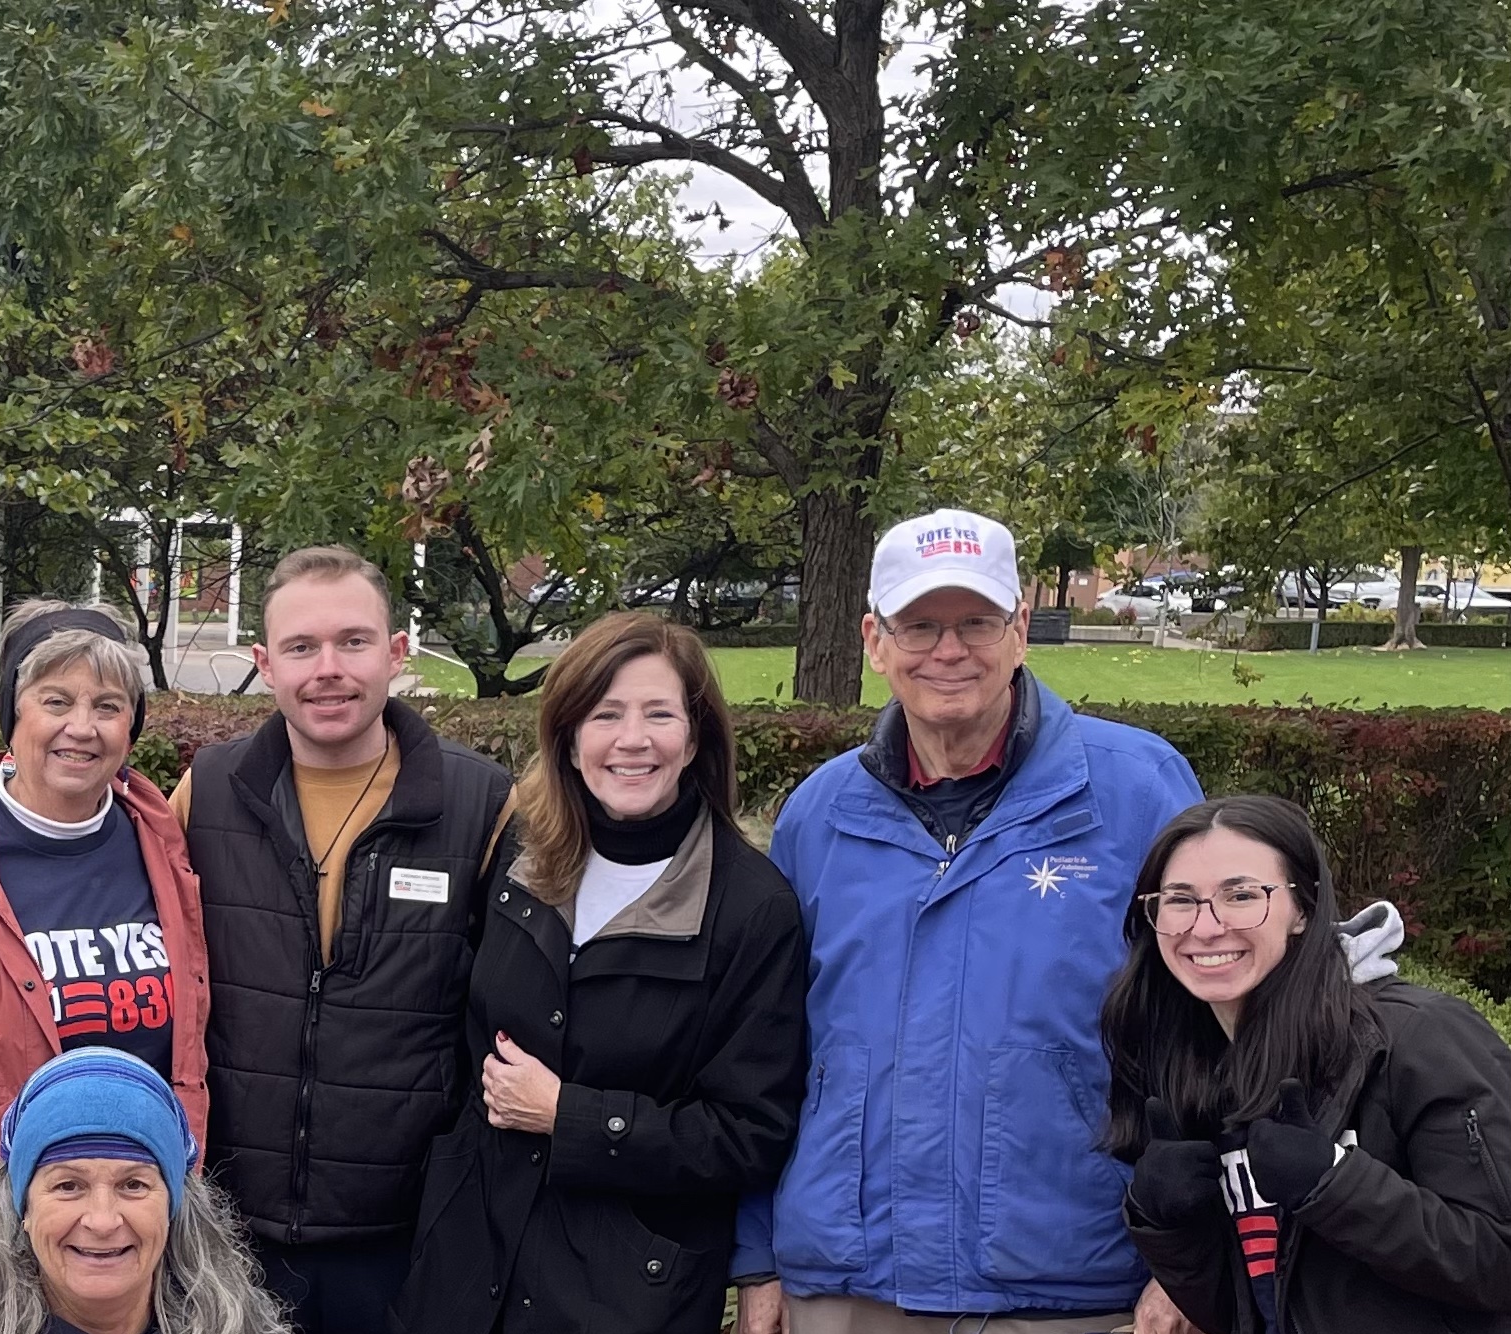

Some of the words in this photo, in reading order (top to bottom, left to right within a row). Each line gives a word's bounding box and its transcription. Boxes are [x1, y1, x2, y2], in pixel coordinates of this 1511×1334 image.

[916, 527, 952, 545] VOTE
[954, 527, 979, 542] YES
[953, 541, 982, 556] 836
[25, 929, 105, 981] OTE
[99, 922, 170, 974] YES
